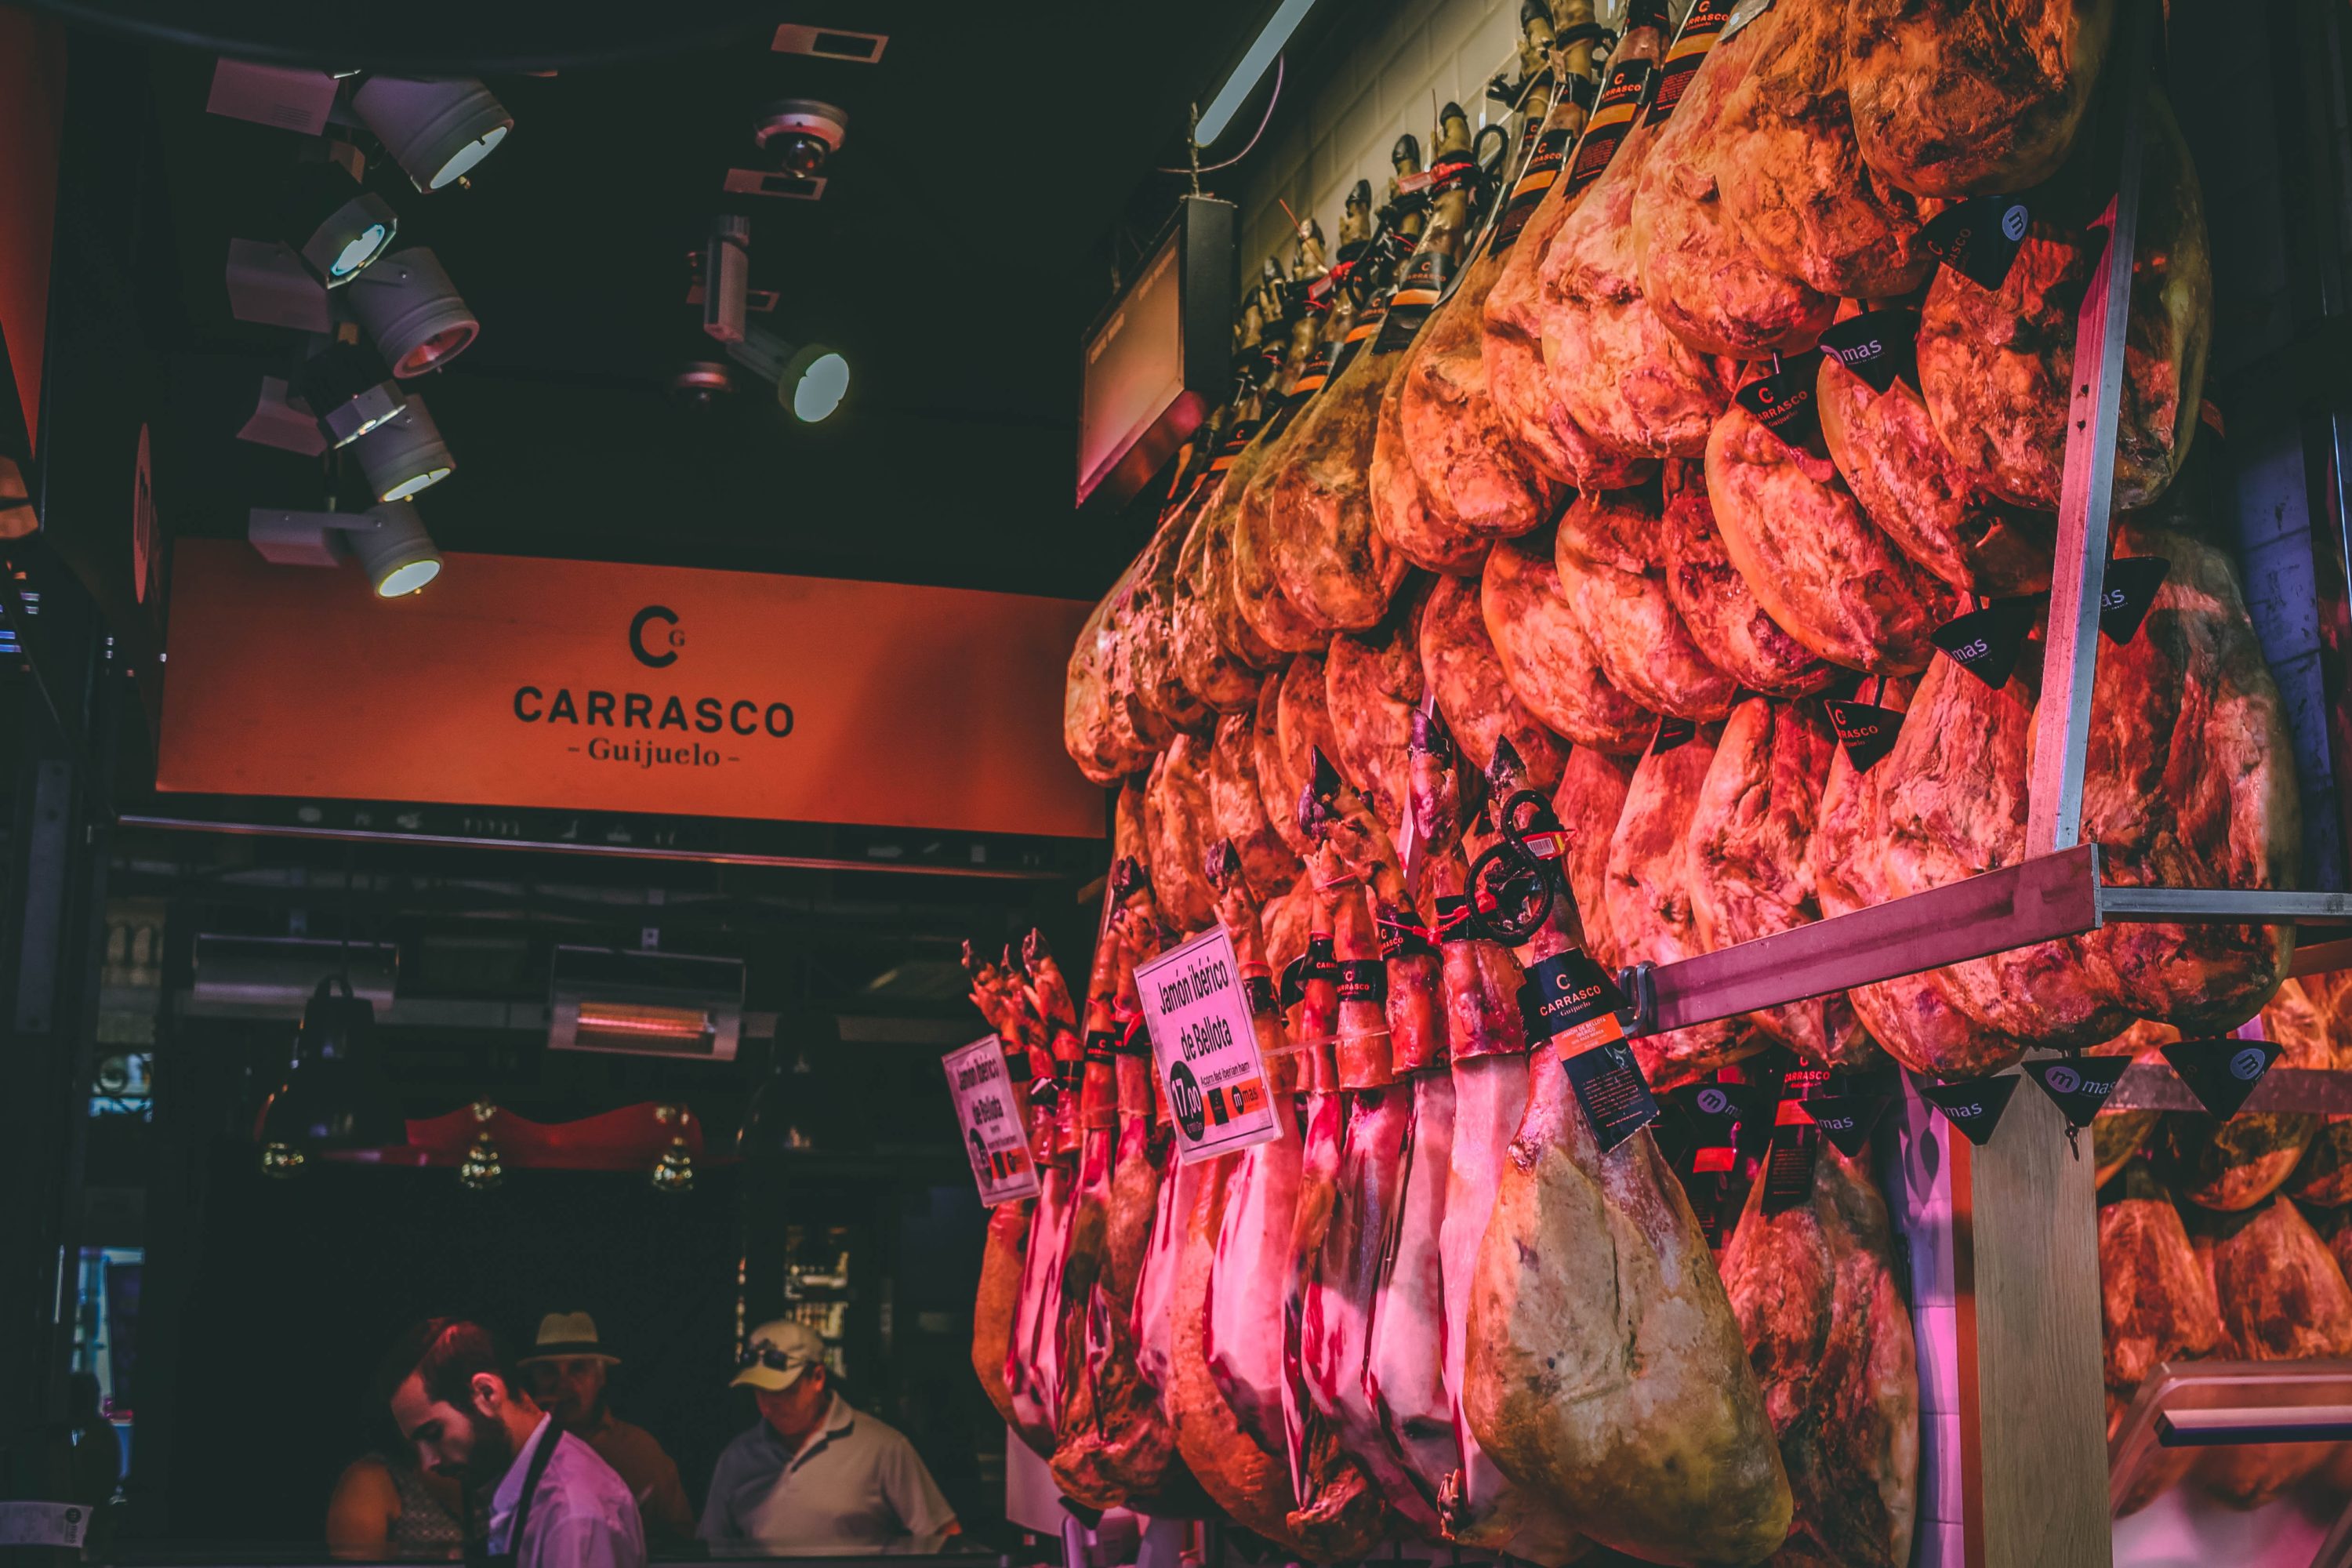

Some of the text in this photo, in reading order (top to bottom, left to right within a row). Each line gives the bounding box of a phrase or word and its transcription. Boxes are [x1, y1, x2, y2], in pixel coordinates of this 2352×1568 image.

[1841, 339, 1882, 361] mas
[1951, 639, 1987, 662] mas
[514, 685, 794, 738] CARRASCO
[1158, 956, 1229, 1015] Jamón ibérico
[1540, 985, 1601, 1016] CARRASCO
[1181, 1015, 1233, 1062] de Bellota
[1171, 1078, 1202, 1120] 17,00
[1944, 1103, 1982, 1117] mas
[1819, 1117, 1853, 1129] mas
